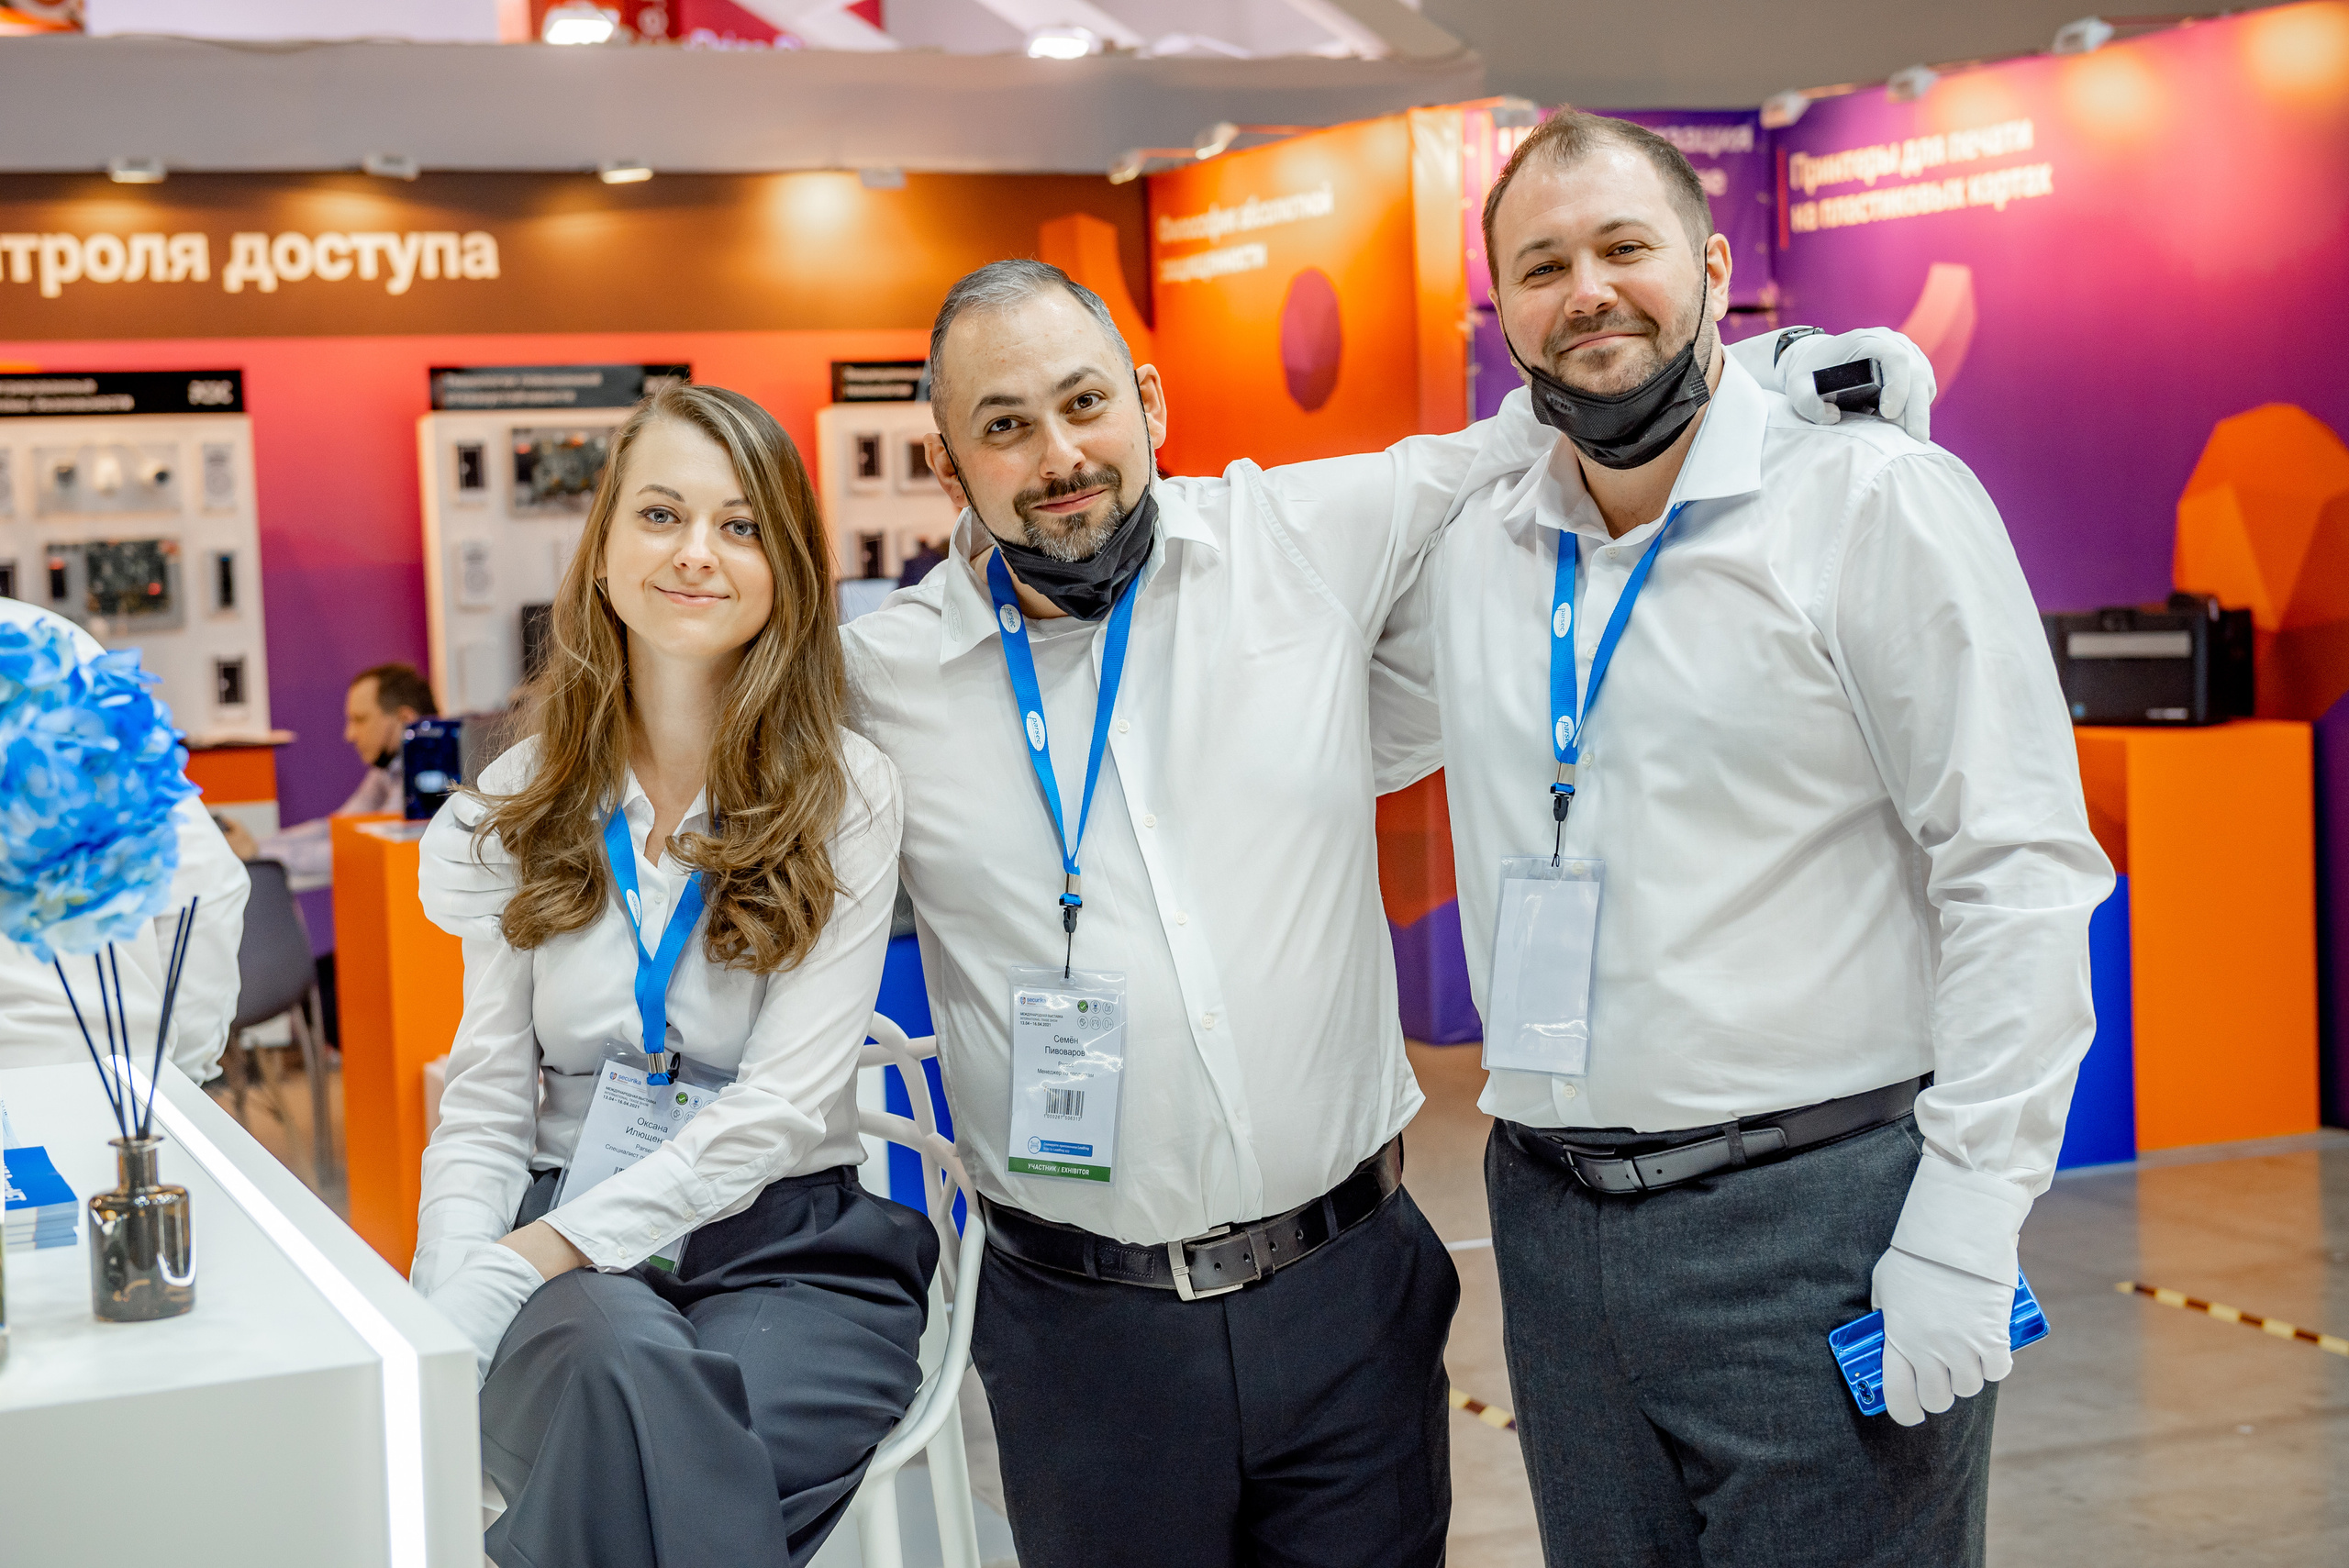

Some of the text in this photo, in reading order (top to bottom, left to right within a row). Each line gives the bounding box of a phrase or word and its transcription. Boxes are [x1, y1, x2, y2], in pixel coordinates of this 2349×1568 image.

[0, 230, 501, 298] троля доступа
[1557, 608, 1566, 631] parsec
[1027, 717, 1041, 745] parsec
[1053, 1034, 1079, 1044] Семён
[1044, 1045, 1085, 1057] Пивоваров
[618, 1074, 642, 1085] securika
[1037, 1068, 1062, 1076] Менеджер
[637, 1117, 669, 1133] Оксана
[625, 1126, 665, 1144] Илющен
[605, 1143, 639, 1159] Специалист
[1028, 1162, 1057, 1172] УЧАСТНИК
[1061, 1166, 1090, 1175] EXHIBITOR
